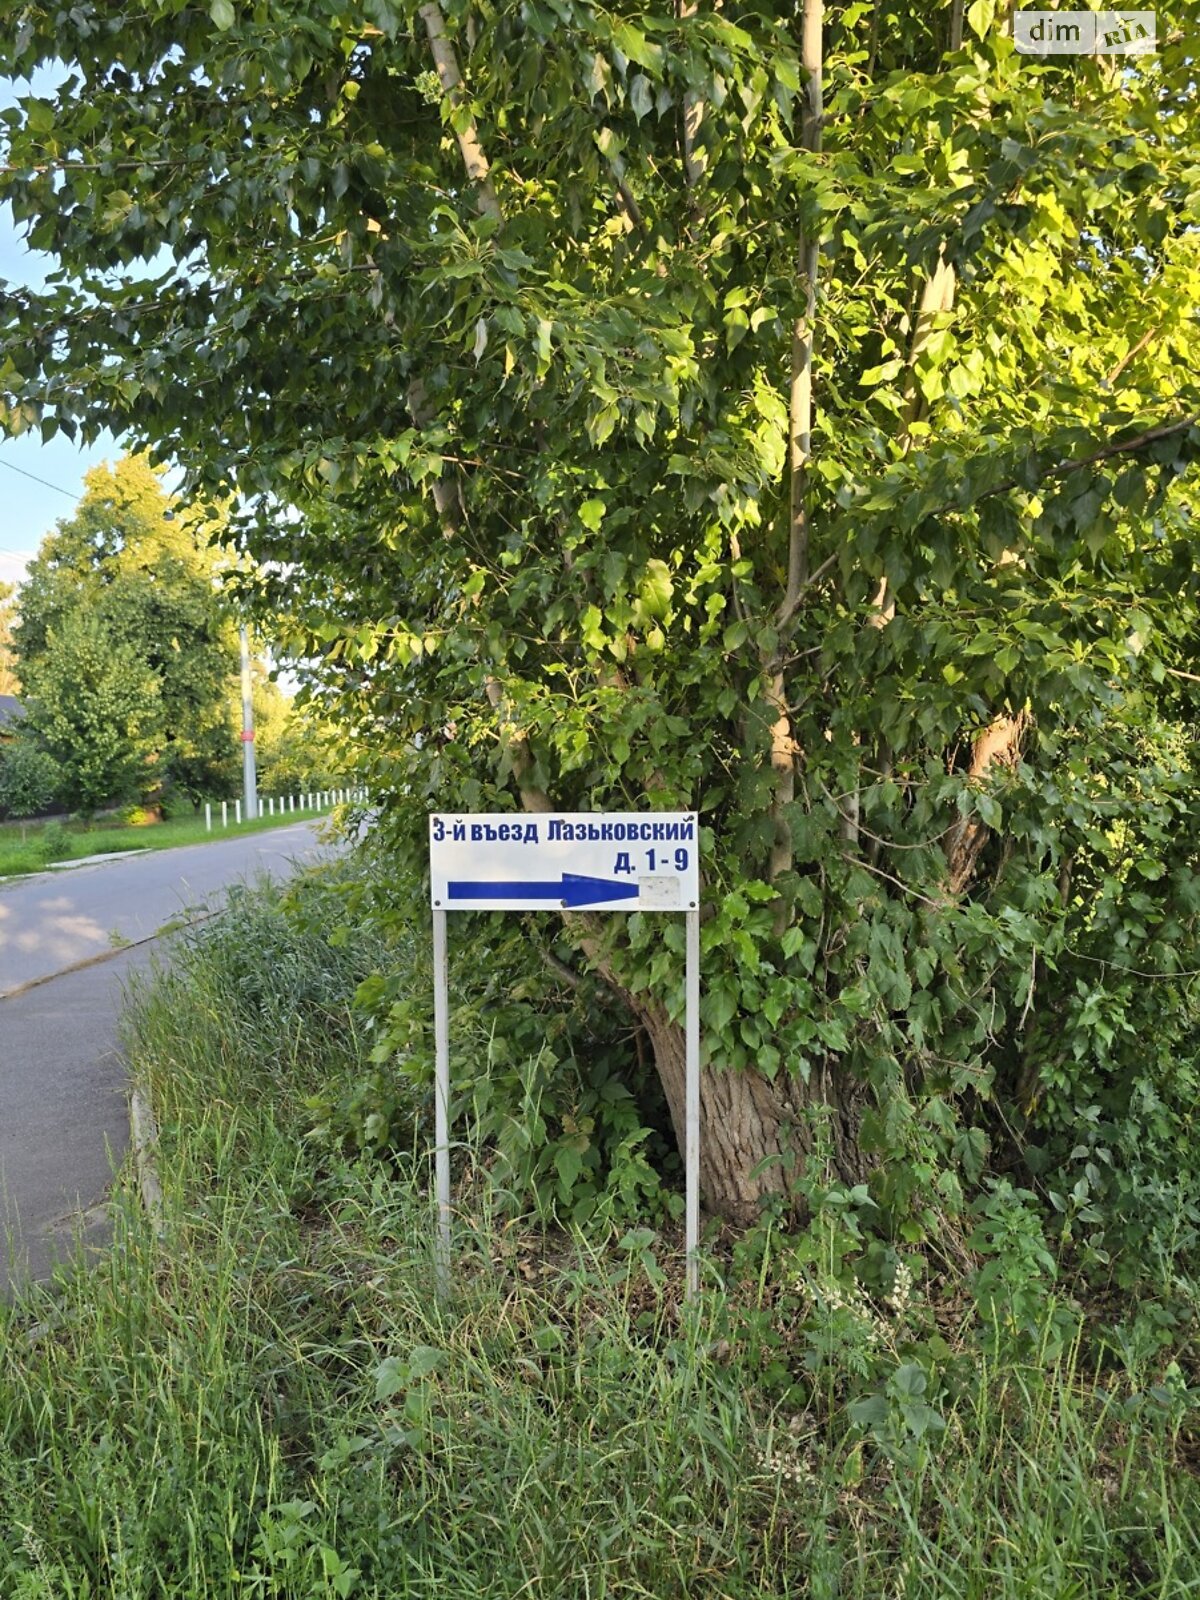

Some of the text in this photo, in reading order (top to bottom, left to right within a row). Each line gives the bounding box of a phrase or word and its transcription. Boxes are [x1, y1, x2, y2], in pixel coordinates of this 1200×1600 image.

[433, 817, 694, 844] 3-й въезд Лазьковский
[613, 852, 636, 874] д.
